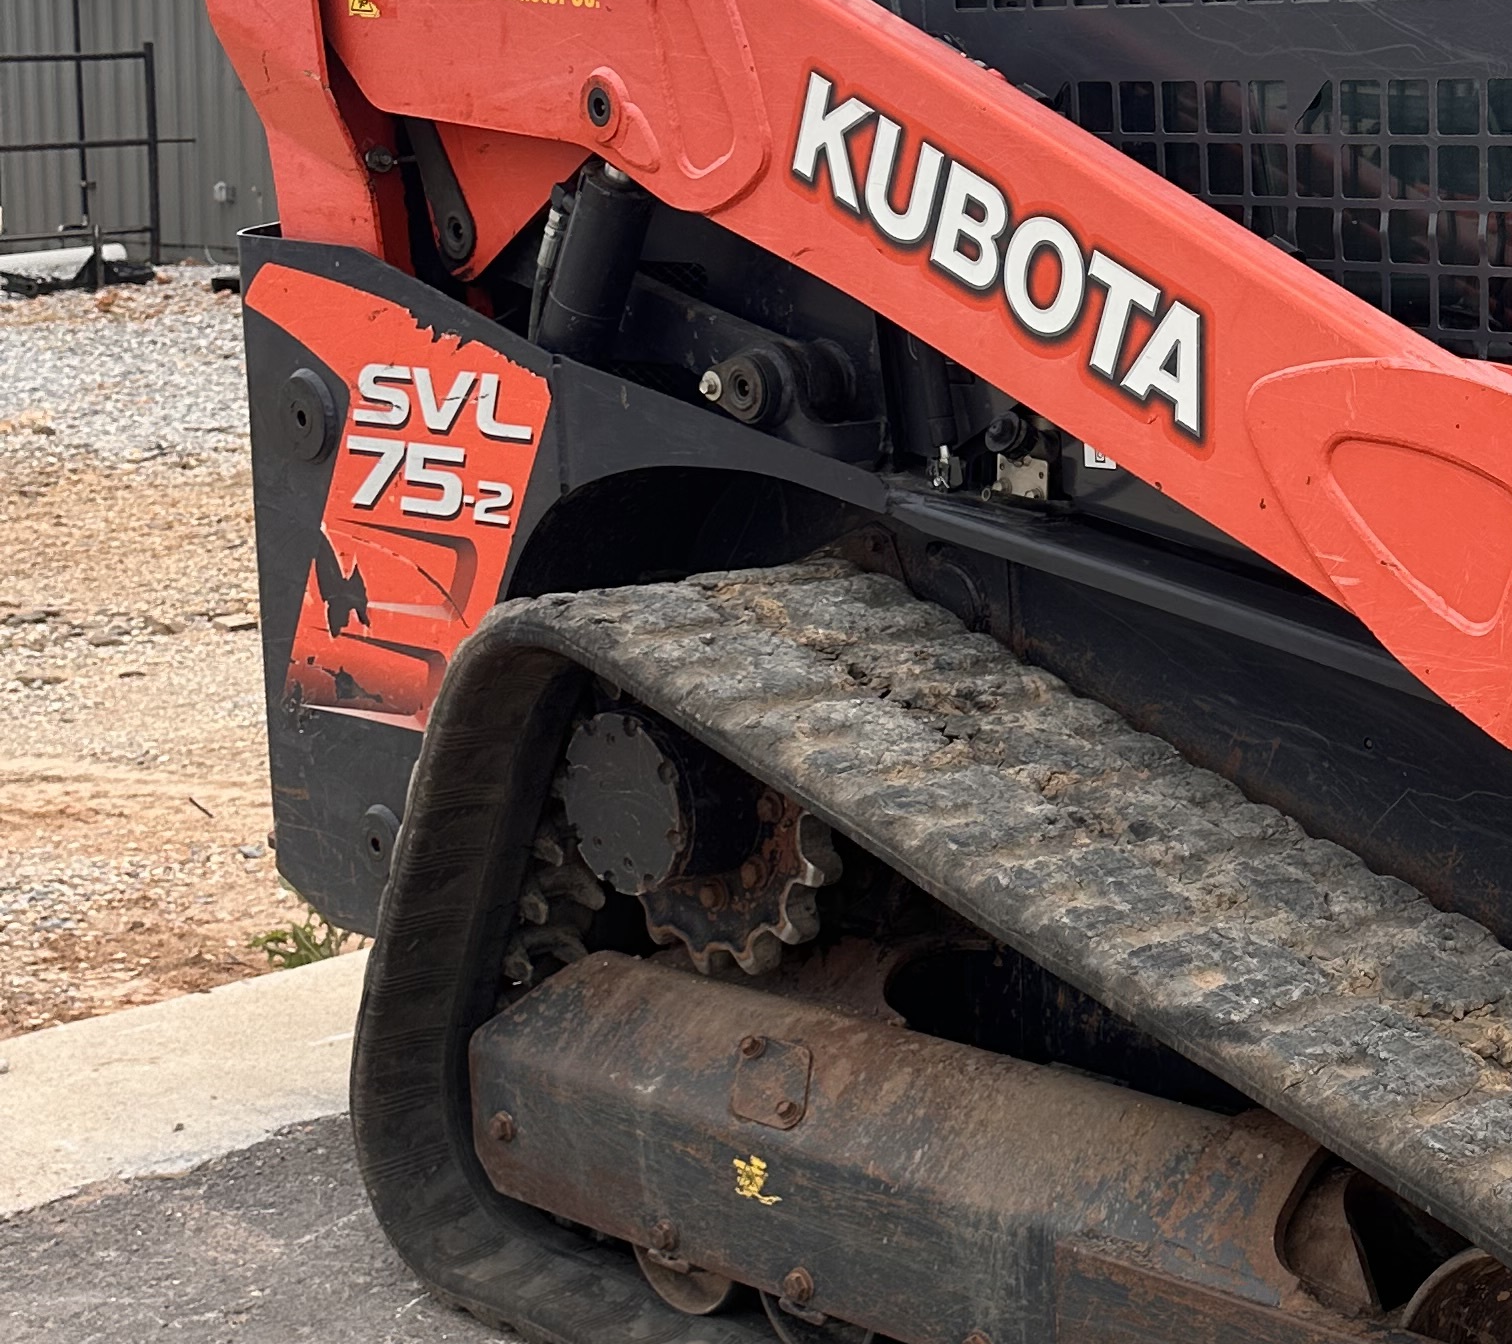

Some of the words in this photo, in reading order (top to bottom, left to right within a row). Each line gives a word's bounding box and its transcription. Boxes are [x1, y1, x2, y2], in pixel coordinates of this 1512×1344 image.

[791, 70, 1201, 438] KUBOTA
[352, 362, 534, 443] SVL
[346, 434, 514, 527] 75-2
